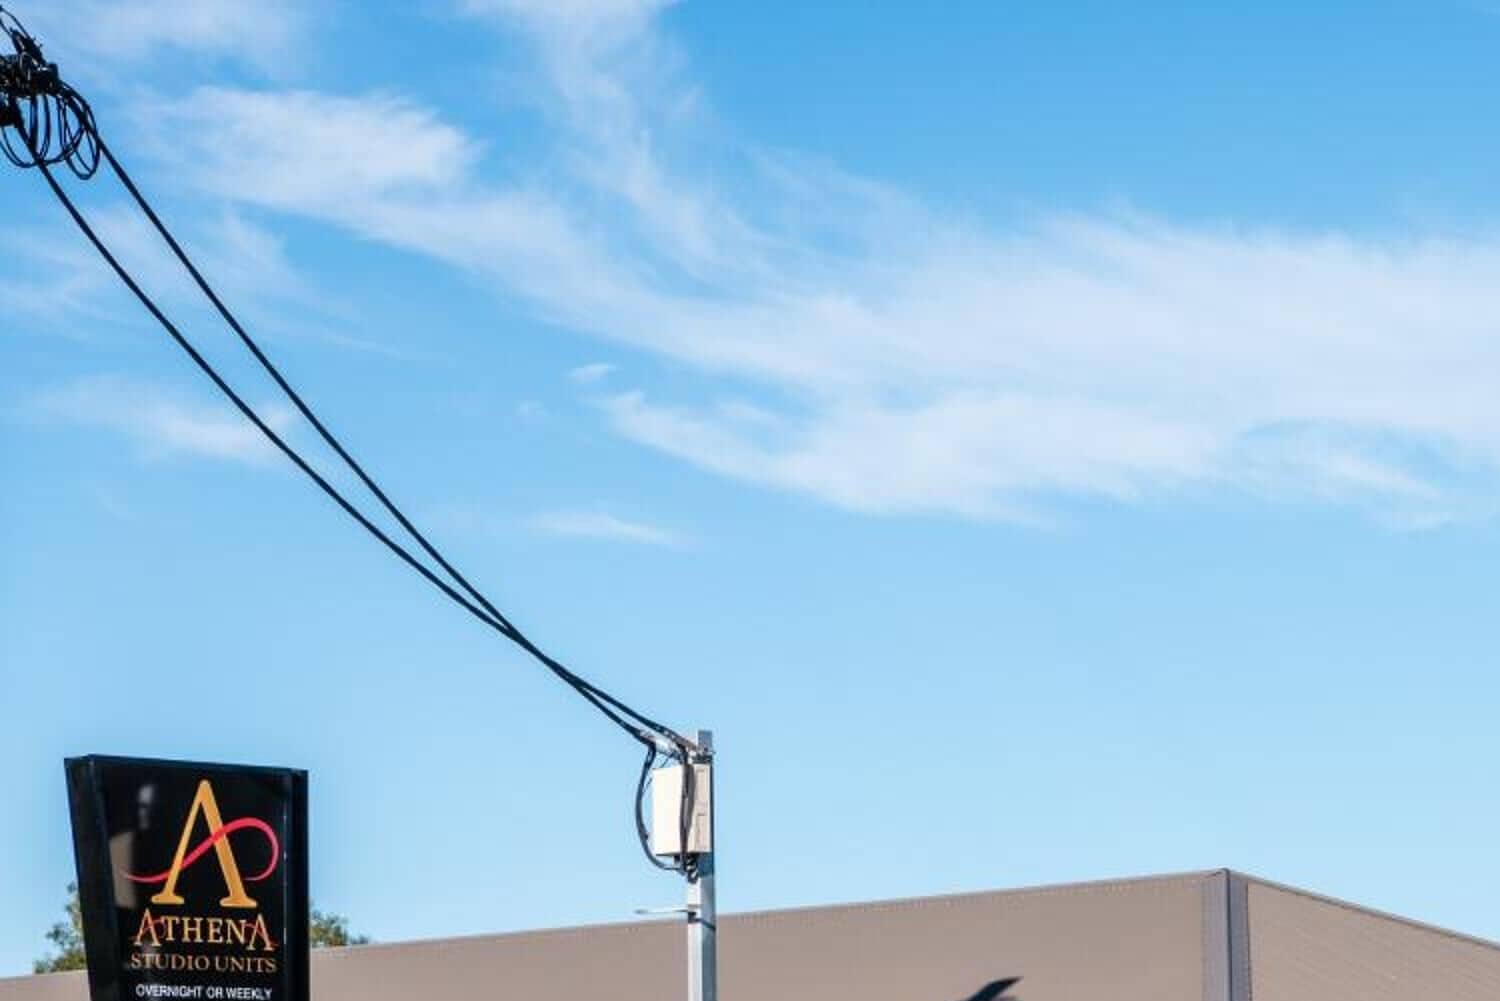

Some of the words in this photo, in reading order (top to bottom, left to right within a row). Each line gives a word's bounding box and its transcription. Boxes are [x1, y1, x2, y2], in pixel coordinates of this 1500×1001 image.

[133, 907, 276, 951] ATHENA
[130, 952, 210, 970] STUDIO
[215, 955, 277, 973] UNITS
[135, 983, 203, 998] OVERNIGHT
[206, 985, 224, 999] OR
[226, 987, 273, 1000] WEEKLY
